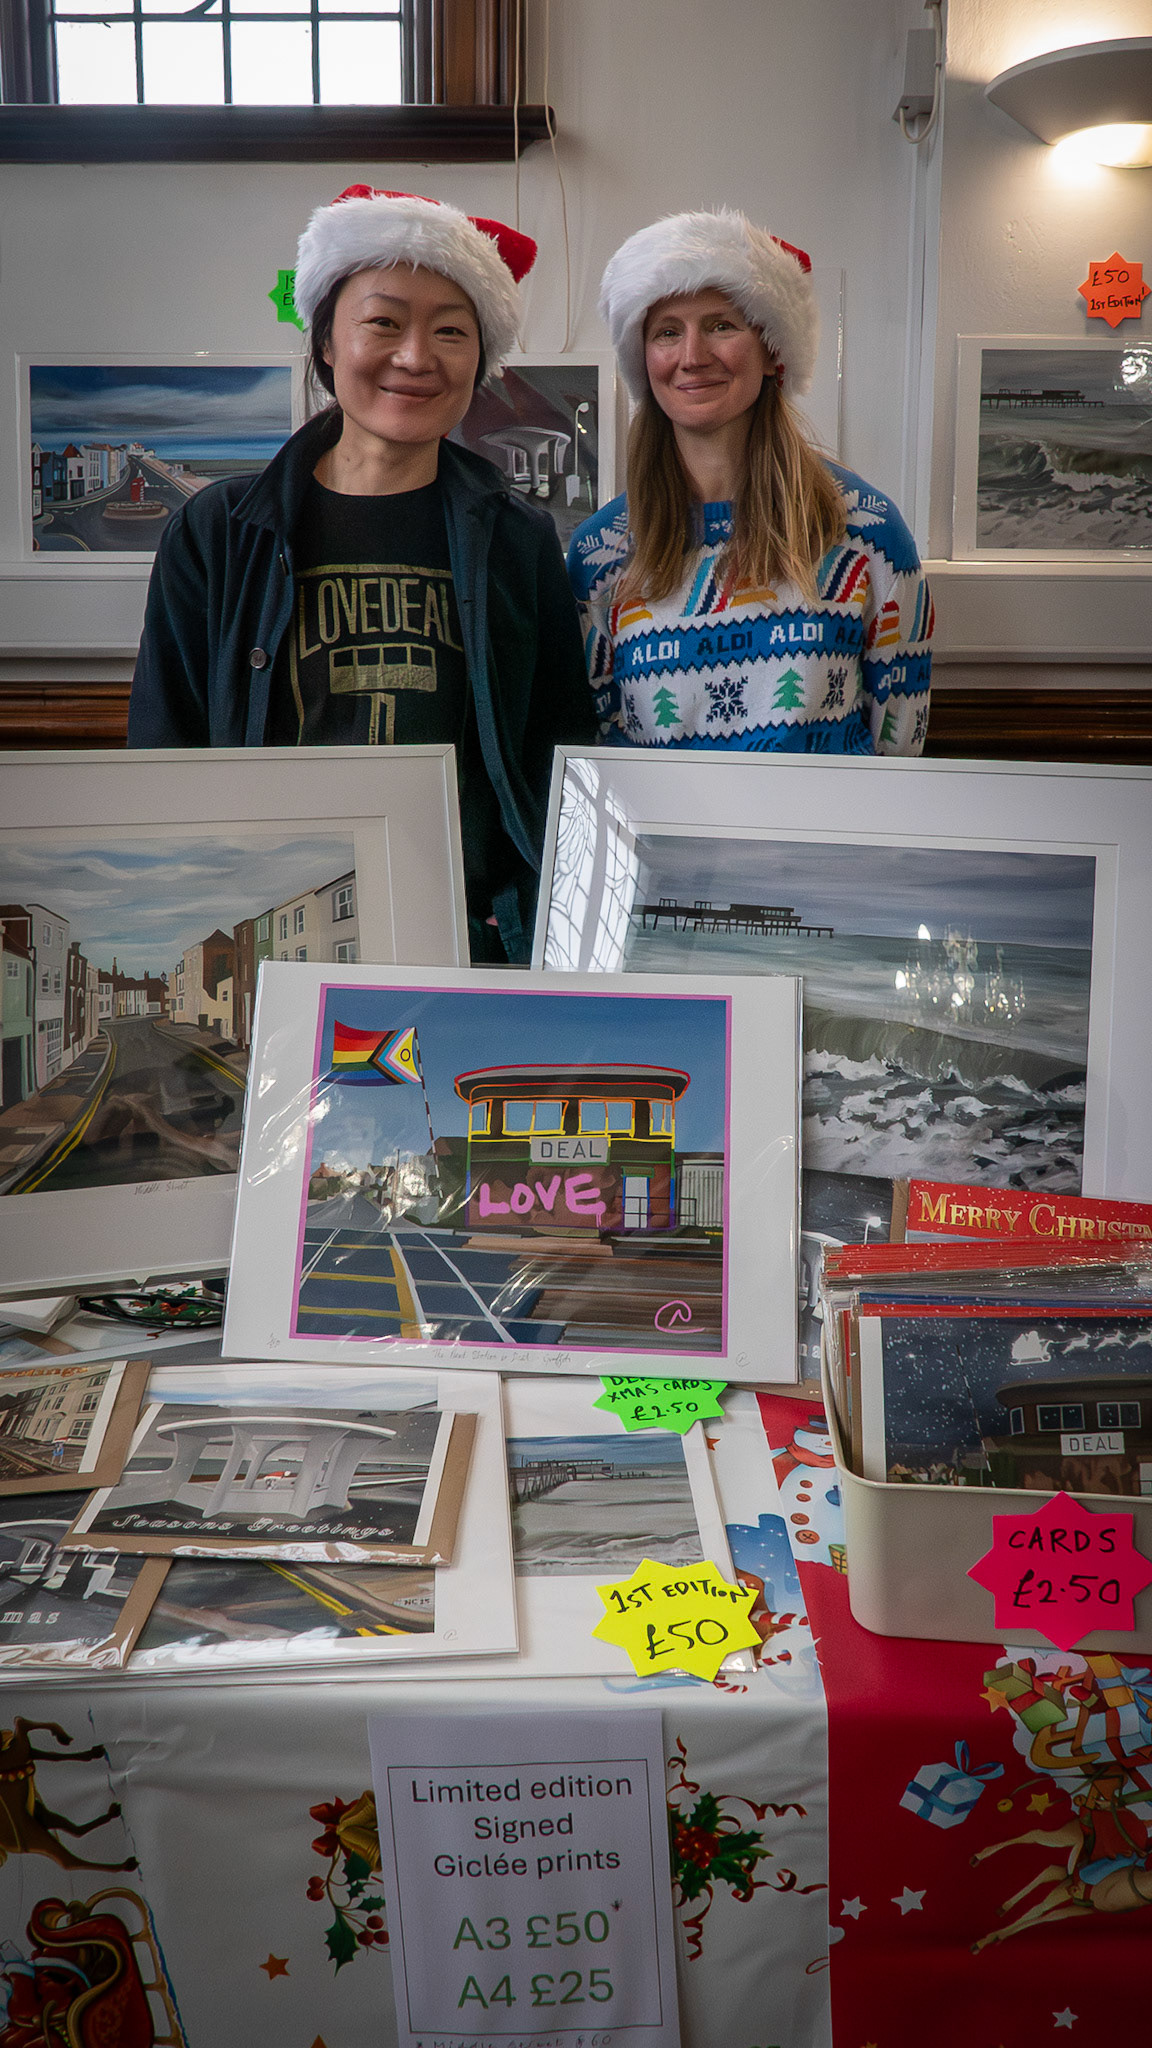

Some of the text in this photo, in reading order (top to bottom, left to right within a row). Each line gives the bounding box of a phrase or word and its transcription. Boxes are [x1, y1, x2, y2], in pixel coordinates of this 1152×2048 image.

[1092, 269, 1130, 287] £50
[1090, 298, 1106, 311] 1ST
[631, 640, 680, 666] ALDI
[696, 631, 753, 656] ALDI
[769, 622, 824, 645] ALDI
[540, 1140, 602, 1159] DEAL
[479, 1173, 607, 1228] LOVE
[918, 1191, 1022, 1232] MERRY
[607, 1379, 713, 1403] XMAS CARDS
[630, 1401, 699, 1421] £2.50
[1069, 1435, 1119, 1452] DEAL
[112, 1513, 394, 1539] Seasons Greetings
[1008, 1526, 1117, 1554] CARDS
[609, 1578, 750, 1614] 1ST EDITION
[646, 1618, 729, 1660] £50
[411, 1774, 632, 1803] Limited edition
[474, 1812, 574, 1844] Signed
[434, 1848, 621, 1879] Giclée prints
[453, 1916, 512, 1951] A3
[457, 1968, 615, 2010] A4 £25
